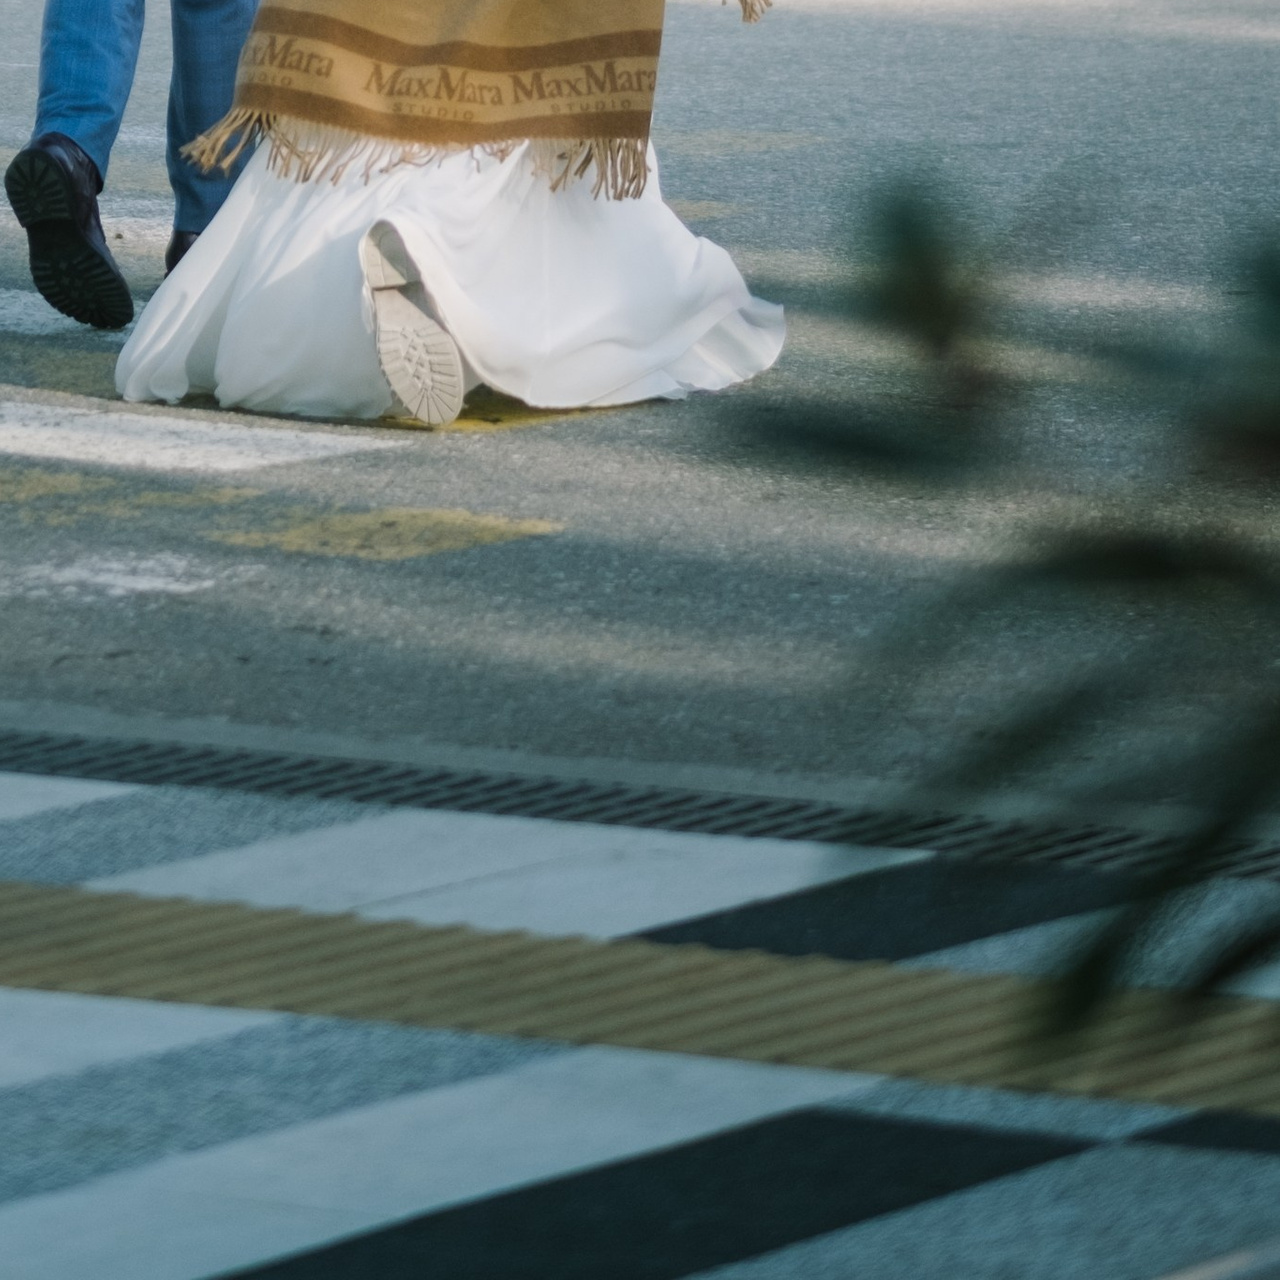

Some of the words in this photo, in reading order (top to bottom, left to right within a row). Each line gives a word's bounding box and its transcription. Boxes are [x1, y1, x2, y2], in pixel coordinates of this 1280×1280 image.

[363, 62, 504, 106] MaxMara
[391, 101, 475, 121] STUDIO
[550, 98, 632, 114] STUDIO
